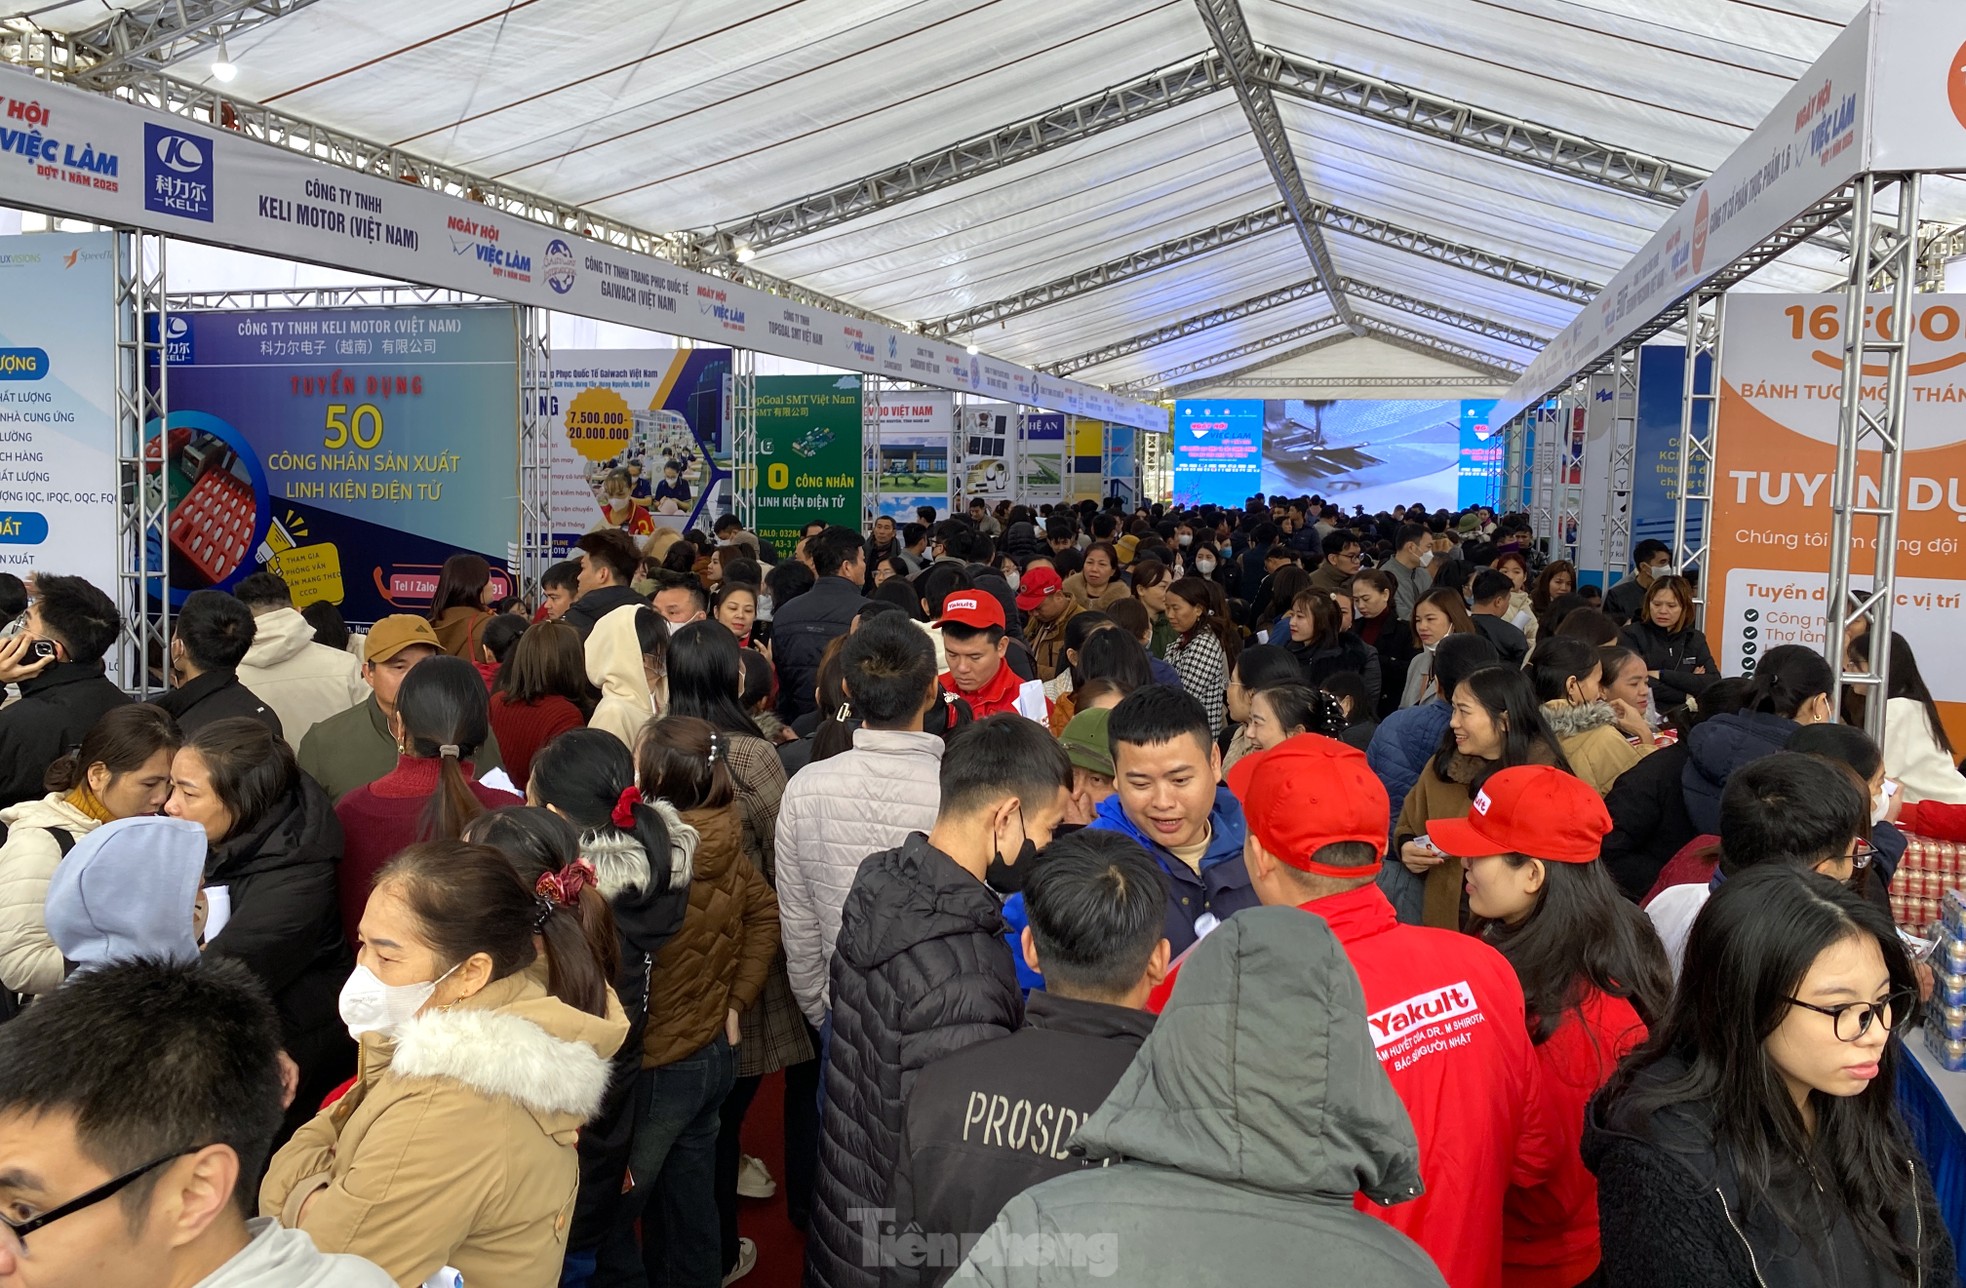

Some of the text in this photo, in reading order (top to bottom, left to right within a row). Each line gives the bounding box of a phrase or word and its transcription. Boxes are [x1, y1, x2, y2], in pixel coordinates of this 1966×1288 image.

[7, 99, 50, 128] HỘI
[0, 127, 119, 177] VIỆC LÀM
[93, 179, 119, 193] 2025
[155, 174, 206, 201] 科力尔
[164, 198, 199, 213] KELI
[305, 180, 382, 214] CÔNG TY TNHH
[259, 195, 419, 252] KELI MOTOR (VIỆT NAM)
[448, 216, 499, 243] NGÀY HỘI
[476, 244, 503, 268] VIỆC
[505, 250, 531, 272] LÀM
[585, 256, 603, 274] CÔNG
[604, 262, 612, 276] TY
[613, 265, 630, 281] TNHH
[630, 269, 649, 286] TRANG
[601, 280, 676, 314] GAIWACH (VIỆT NAM)
[238, 315, 461, 337] CÔNG TY TNHH KELI MOTOR (VIỆT NAM)
[768, 321, 790, 339] TOPGOAL
[600, 369, 628, 379] Gaiwach
[643, 370, 658, 378] Nam
[367, 375, 423, 400] DỤNG
[1740, 379, 1798, 399] BÁNH
[18, 391, 52, 405] LƯỢNG
[786, 395, 855, 406] SMT Việt Nam
[23, 412, 51, 423] CUNG
[53, 410, 75, 423] ỨNG
[891, 404, 910, 418] VIỆT
[912, 406, 933, 416] NAM
[323, 402, 384, 450] 50
[569, 427, 629, 440] 20.000.000
[1044, 422, 1058, 430] AN
[15, 452, 43, 462] HÀNG
[268, 448, 460, 473] CÔNG NHÂN SẢN XUẤT
[16, 470, 50, 484] LƯỢNG
[796, 473, 855, 488] CÔNG NHÂN
[25, 492, 45, 503] IQC,
[46, 493, 72, 504] IPQC,
[74, 493, 99, 504] OQC,
[286, 479, 443, 504] LINH KIỆN ĐIỆN TỬ
[758, 497, 780, 507] LINH
[783, 493, 805, 511] KIỆN
[807, 493, 829, 511] ĐIỆN
[832, 494, 846, 508] TỬ
[1735, 529, 1958, 557] Chúng tôi đội
[9, 552, 35, 565] XUẤT
[287, 552, 320, 563] THAM GIA
[302, 575, 322, 585] MANG
[395, 580, 437, 592] Tel Zalo:
[299, 587, 318, 597] CCCD
[1746, 583, 1961, 610] Tuyển vị trí
[1766, 611, 1811, 628] Công
[1765, 628, 1796, 643] Thợ
[1368, 988, 1470, 1037] Yakult
[1389, 1036, 1413, 1057] HUYẾT
[1426, 1026, 1444, 1038] DR.
[1445, 1023, 1453, 1034] M
[1453, 1013, 1485, 1030] SHIROTA
[1449, 1033, 1472, 1048] NHẬT
[963, 1091, 1089, 1160] PROSD
